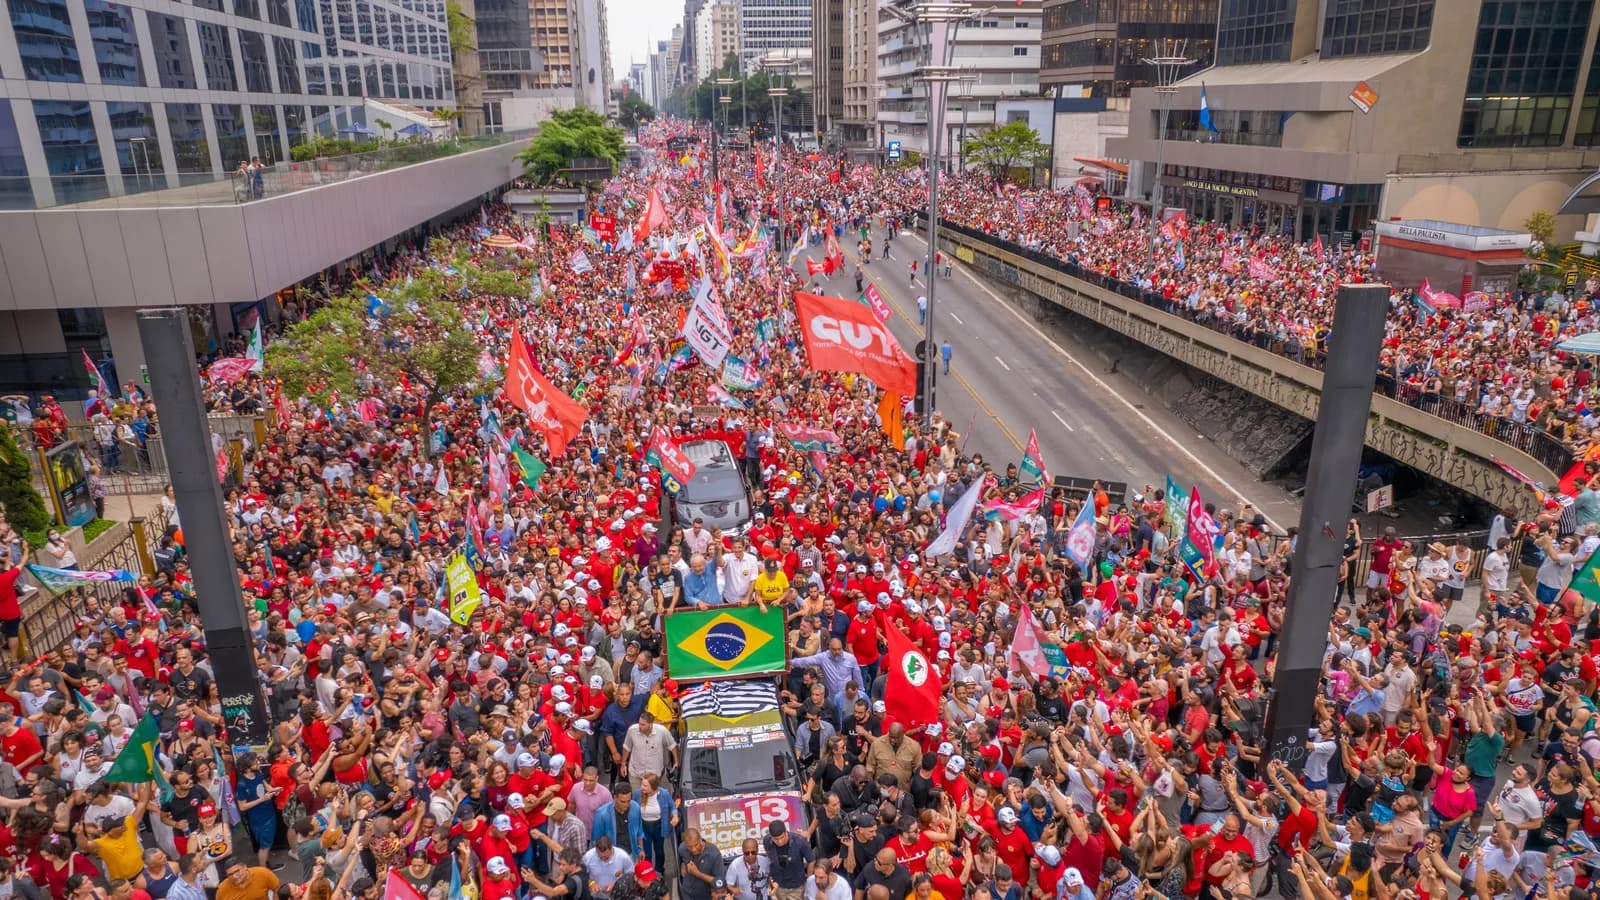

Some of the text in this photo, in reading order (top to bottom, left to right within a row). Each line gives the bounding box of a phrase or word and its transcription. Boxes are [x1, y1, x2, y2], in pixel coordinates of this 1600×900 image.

[1231, 187, 1259, 197] ARGENTINA
[1398, 227, 1417, 238] BELLA
[1417, 230, 1446, 241] PAULISTA
[695, 317, 723, 350] UGT
[699, 808, 745, 824] Lula
[745, 797, 790, 825] 13
